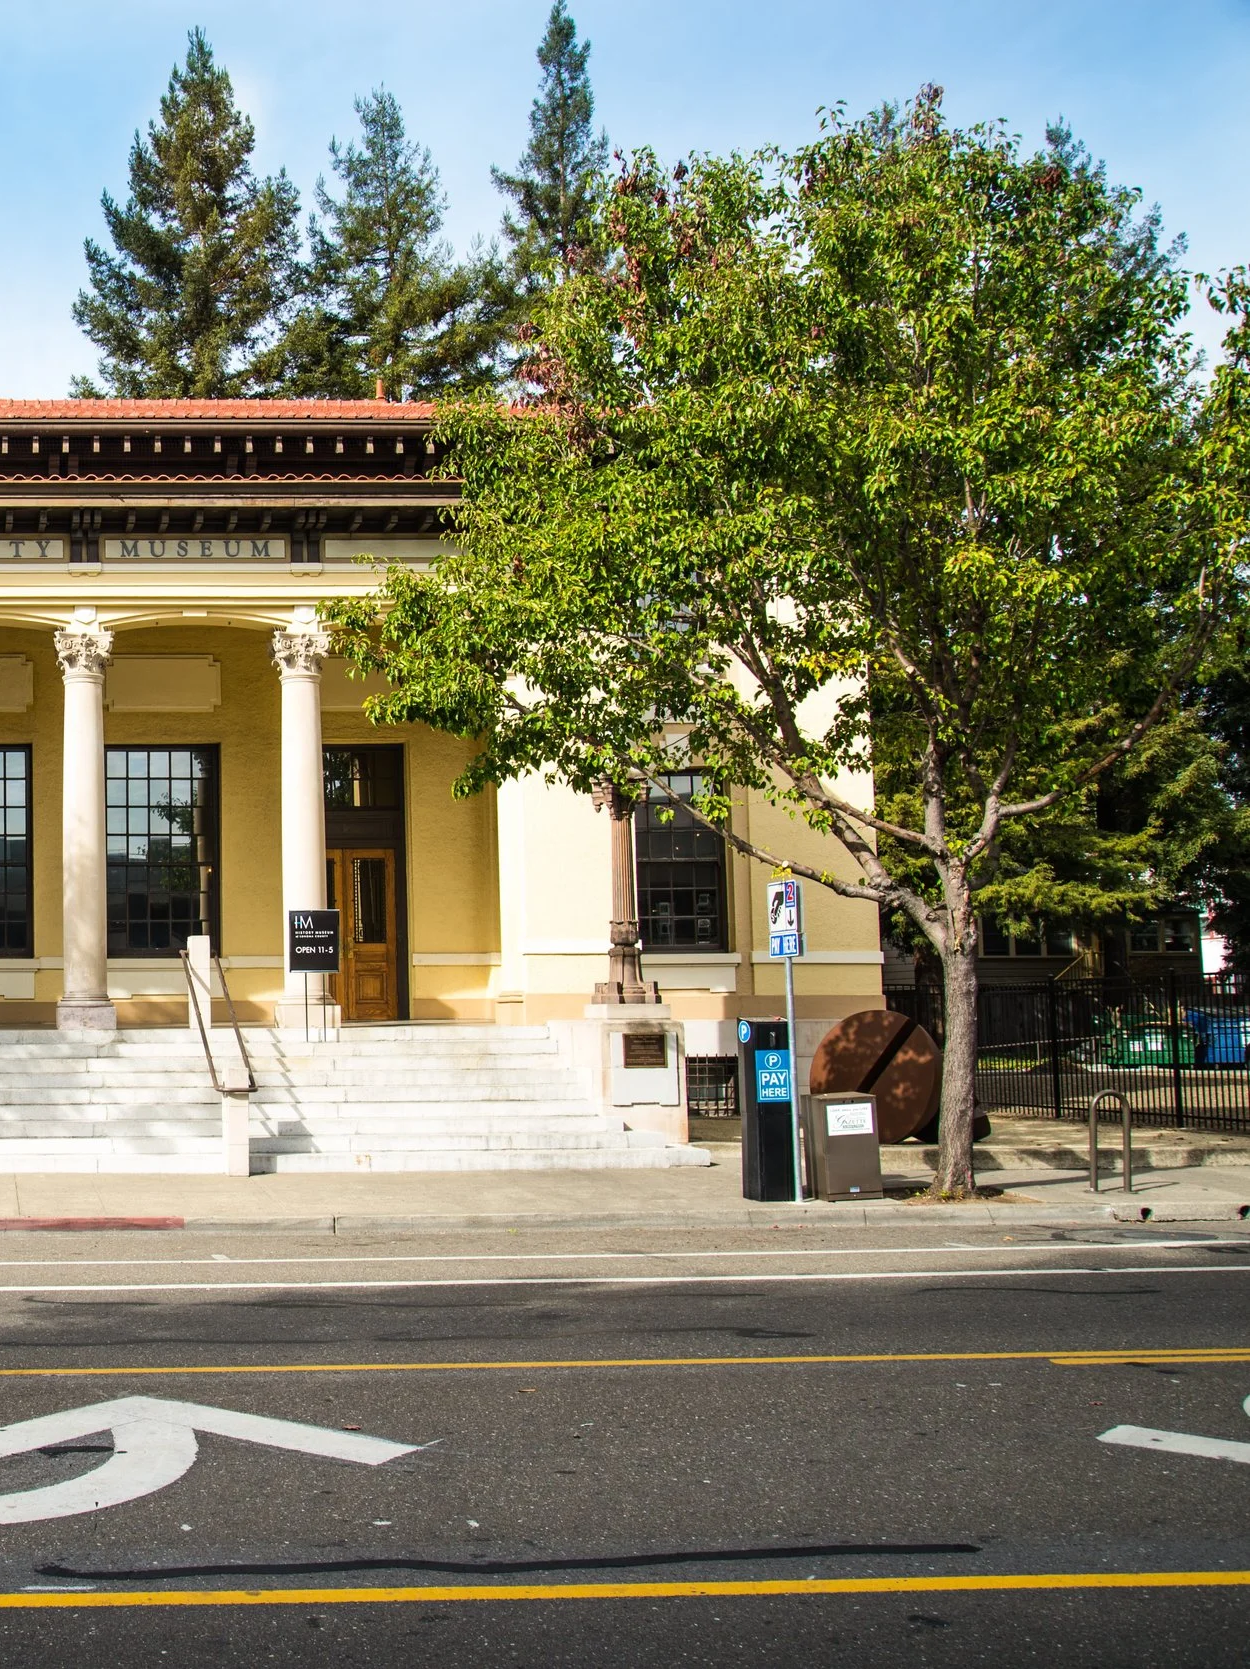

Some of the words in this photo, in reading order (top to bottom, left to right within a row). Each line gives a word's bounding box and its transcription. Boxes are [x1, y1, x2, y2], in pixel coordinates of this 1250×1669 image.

[120, 540, 271, 558] MUSEUM
[786, 883, 794, 901] 2
[295, 946, 316, 954] OPEN
[771, 937, 781, 955] PAY
[783, 935, 797, 954] HERE
[741, 1024, 748, 1040] P
[768, 1055, 778, 1067] P
[761, 1072, 787, 1086] PAY
[761, 1087, 787, 1098] HERE
